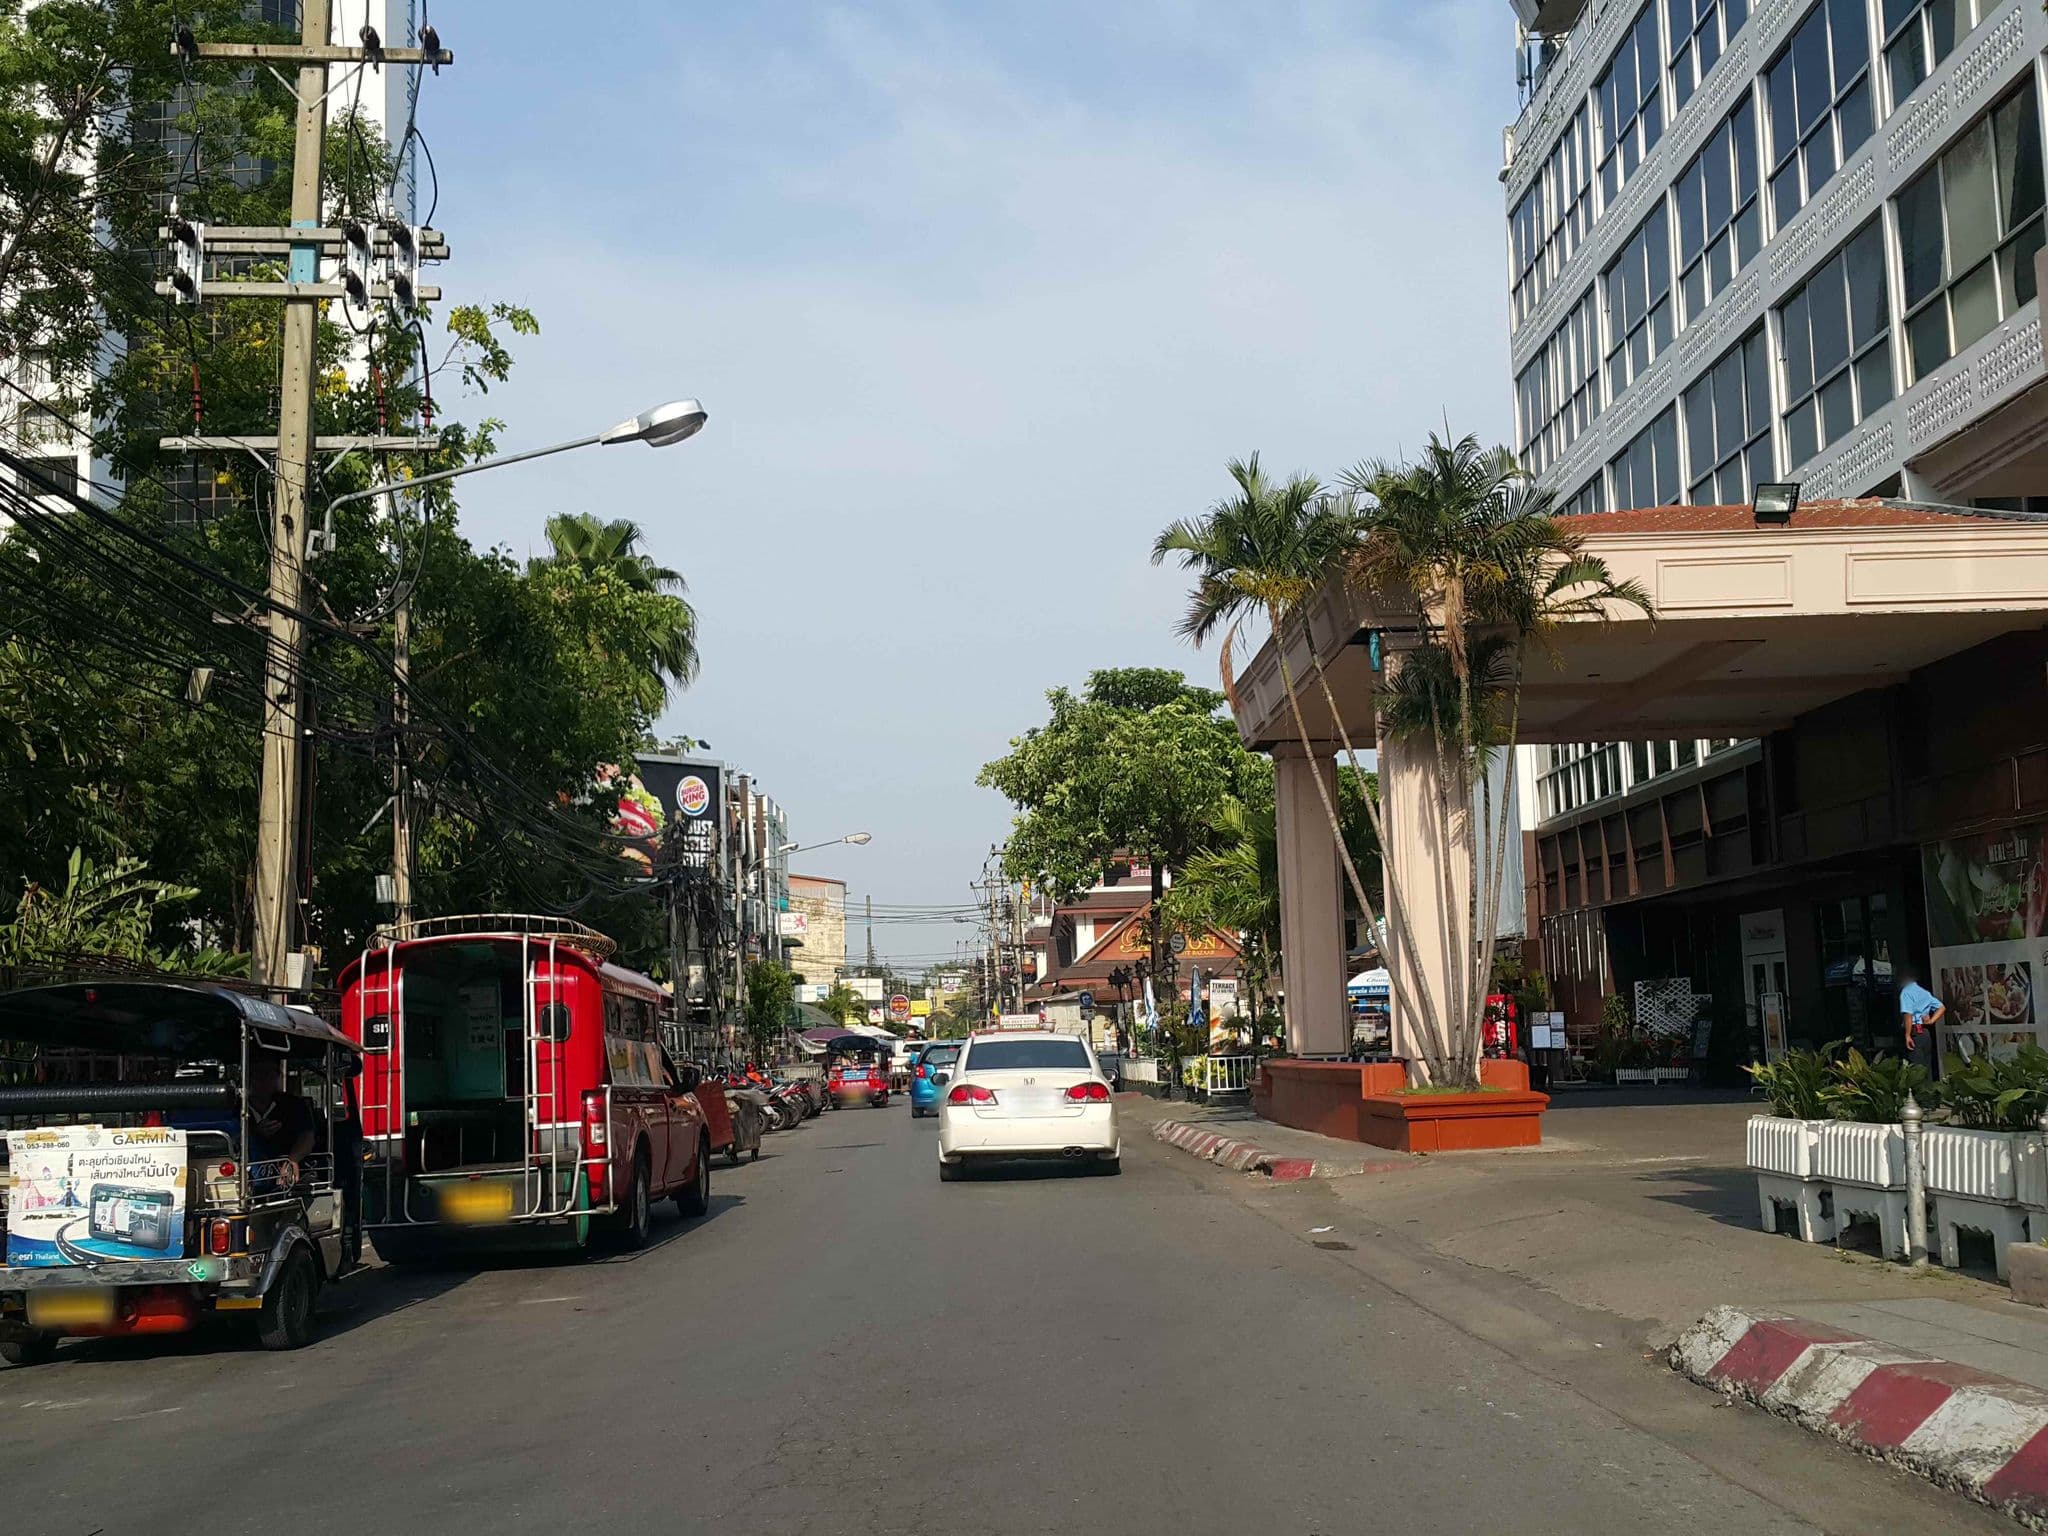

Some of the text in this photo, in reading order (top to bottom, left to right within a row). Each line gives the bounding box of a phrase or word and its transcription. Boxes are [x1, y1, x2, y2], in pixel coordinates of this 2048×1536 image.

[681, 784, 704, 797] BURGER
[682, 790, 705, 806] KING
[688, 820, 714, 835] JUST
[1212, 982, 1236, 990] TERRACE
[112, 1132, 177, 1146] GARMIN
[18, 1252, 33, 1261] esri
